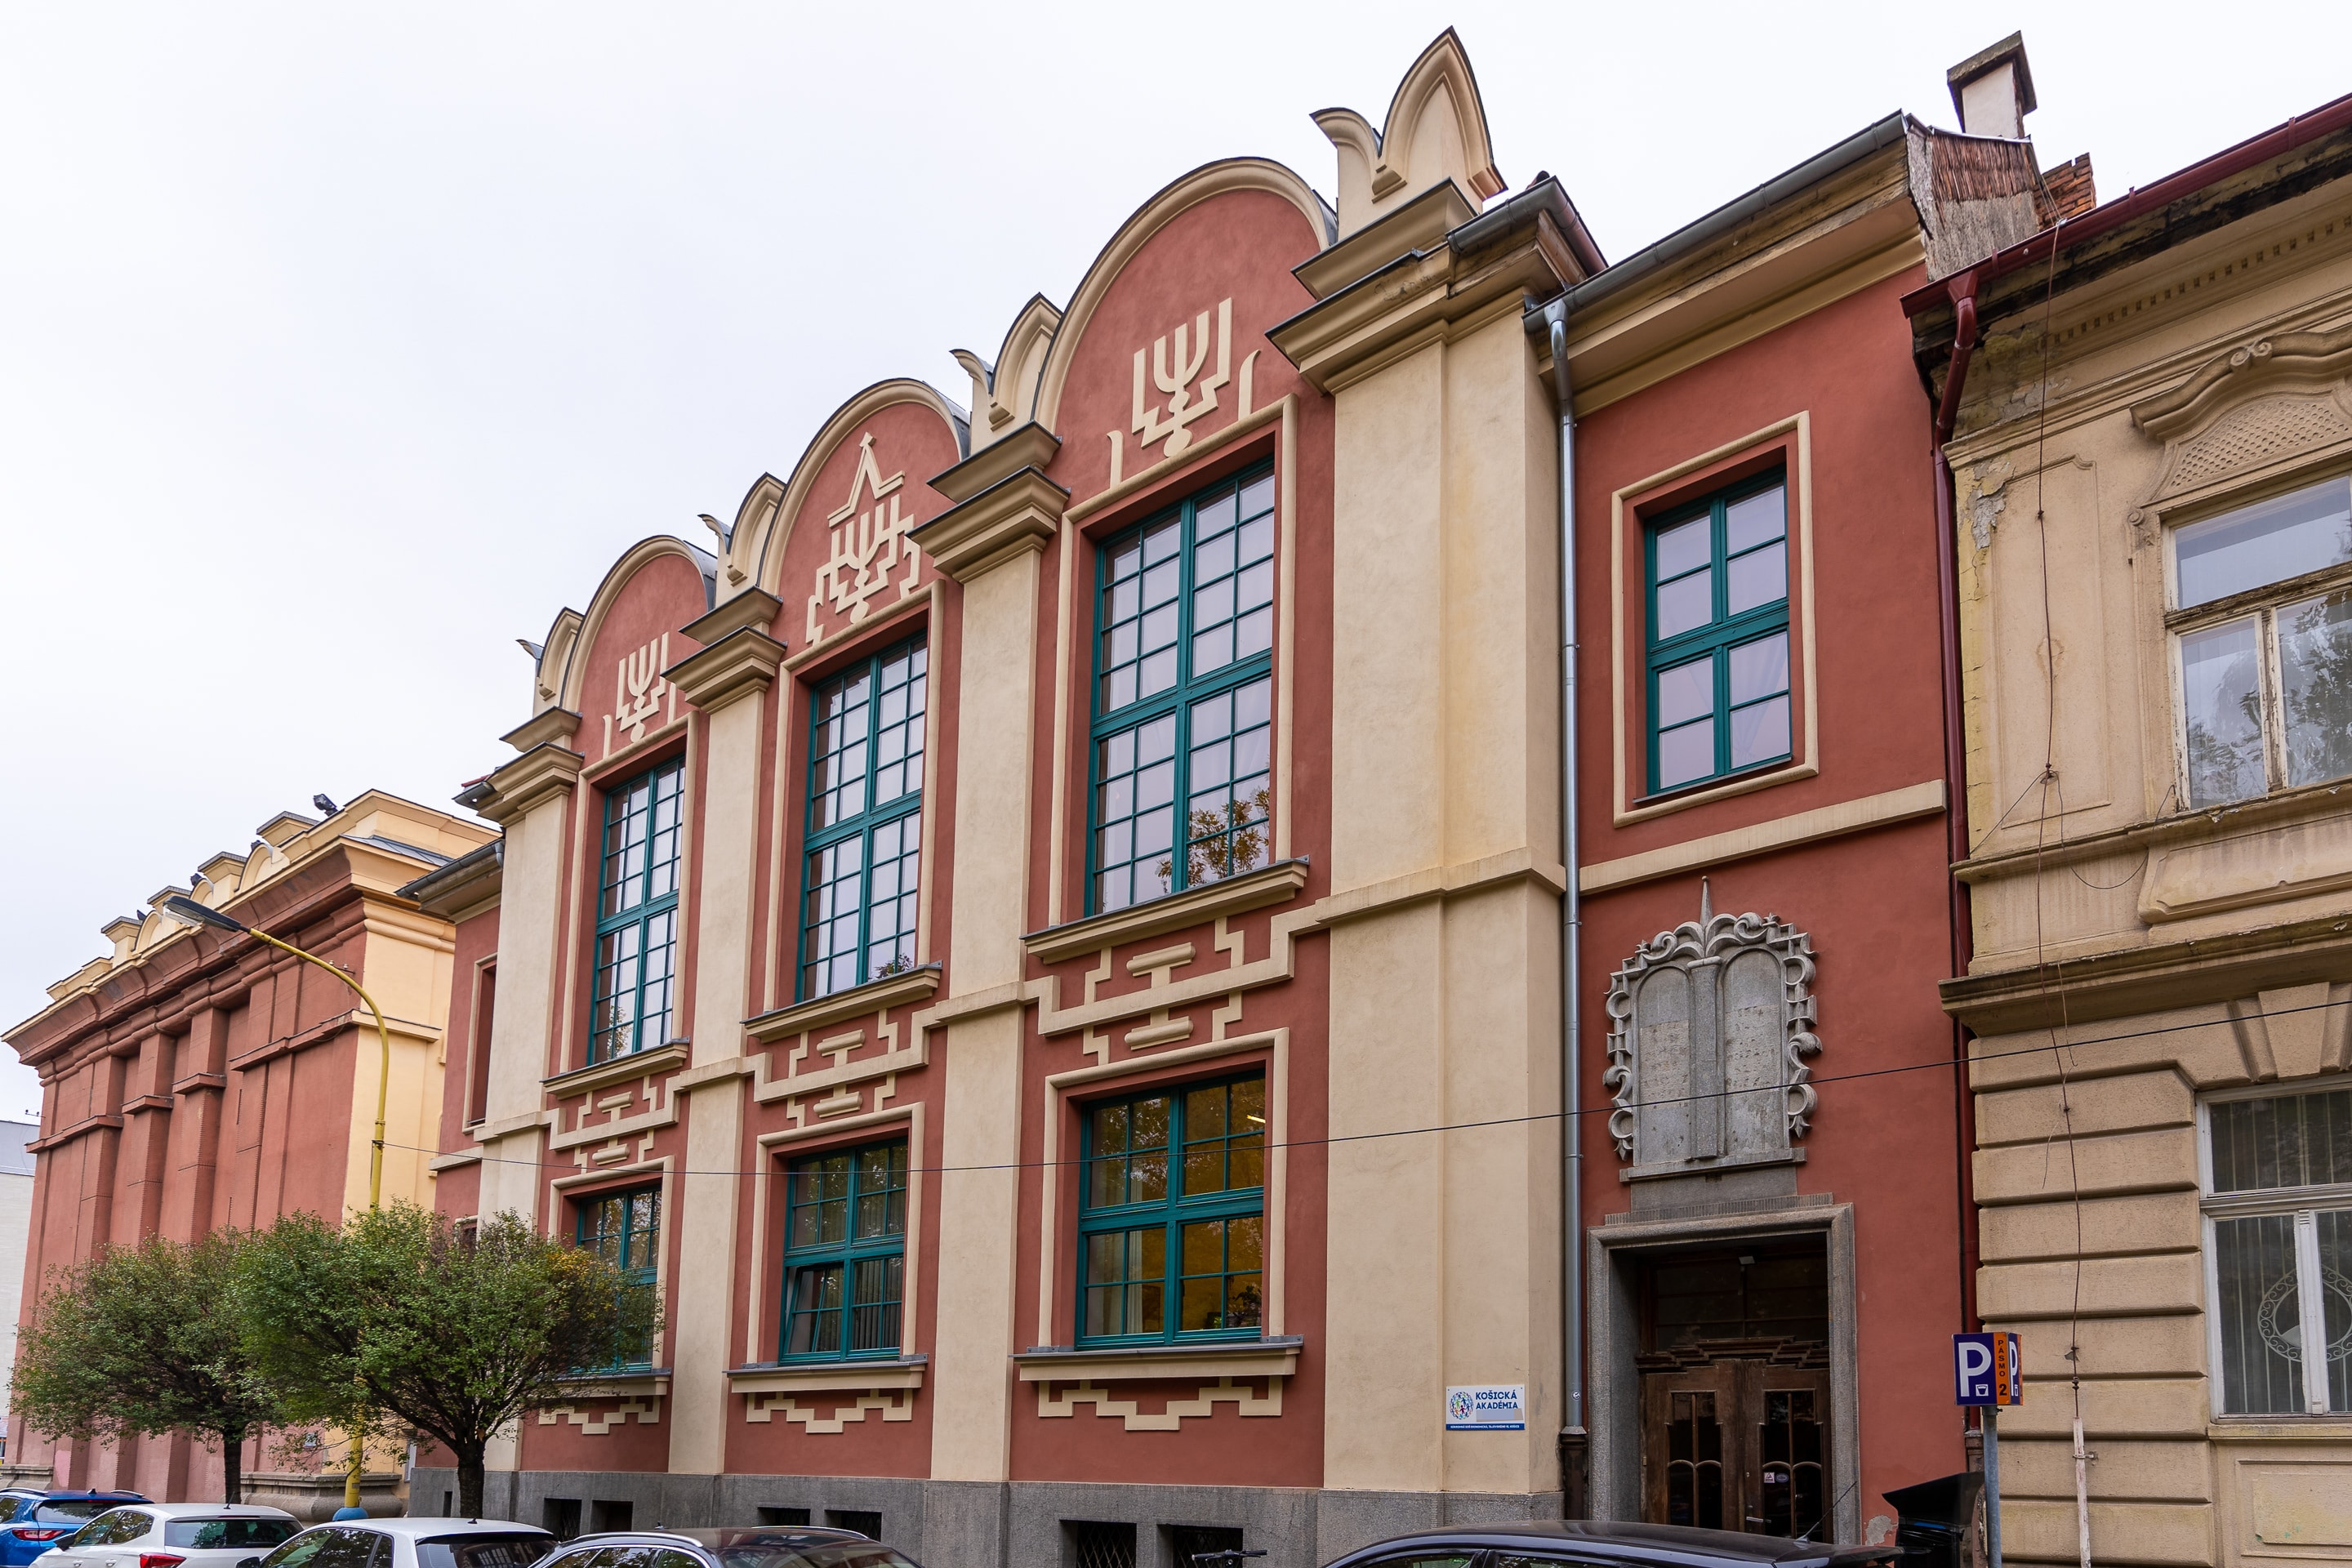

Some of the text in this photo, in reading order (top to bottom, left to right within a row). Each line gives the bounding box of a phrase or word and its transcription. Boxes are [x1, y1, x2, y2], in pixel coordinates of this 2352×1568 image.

[1475, 1389, 1517, 1401] KOŠICKÁ
[1958, 1342, 1992, 1397] P
[1998, 1339, 2007, 1396] PÁSMO 2
[2009, 1341, 2018, 1396] P
[1476, 1401, 1518, 1410] AKADÉMIA
